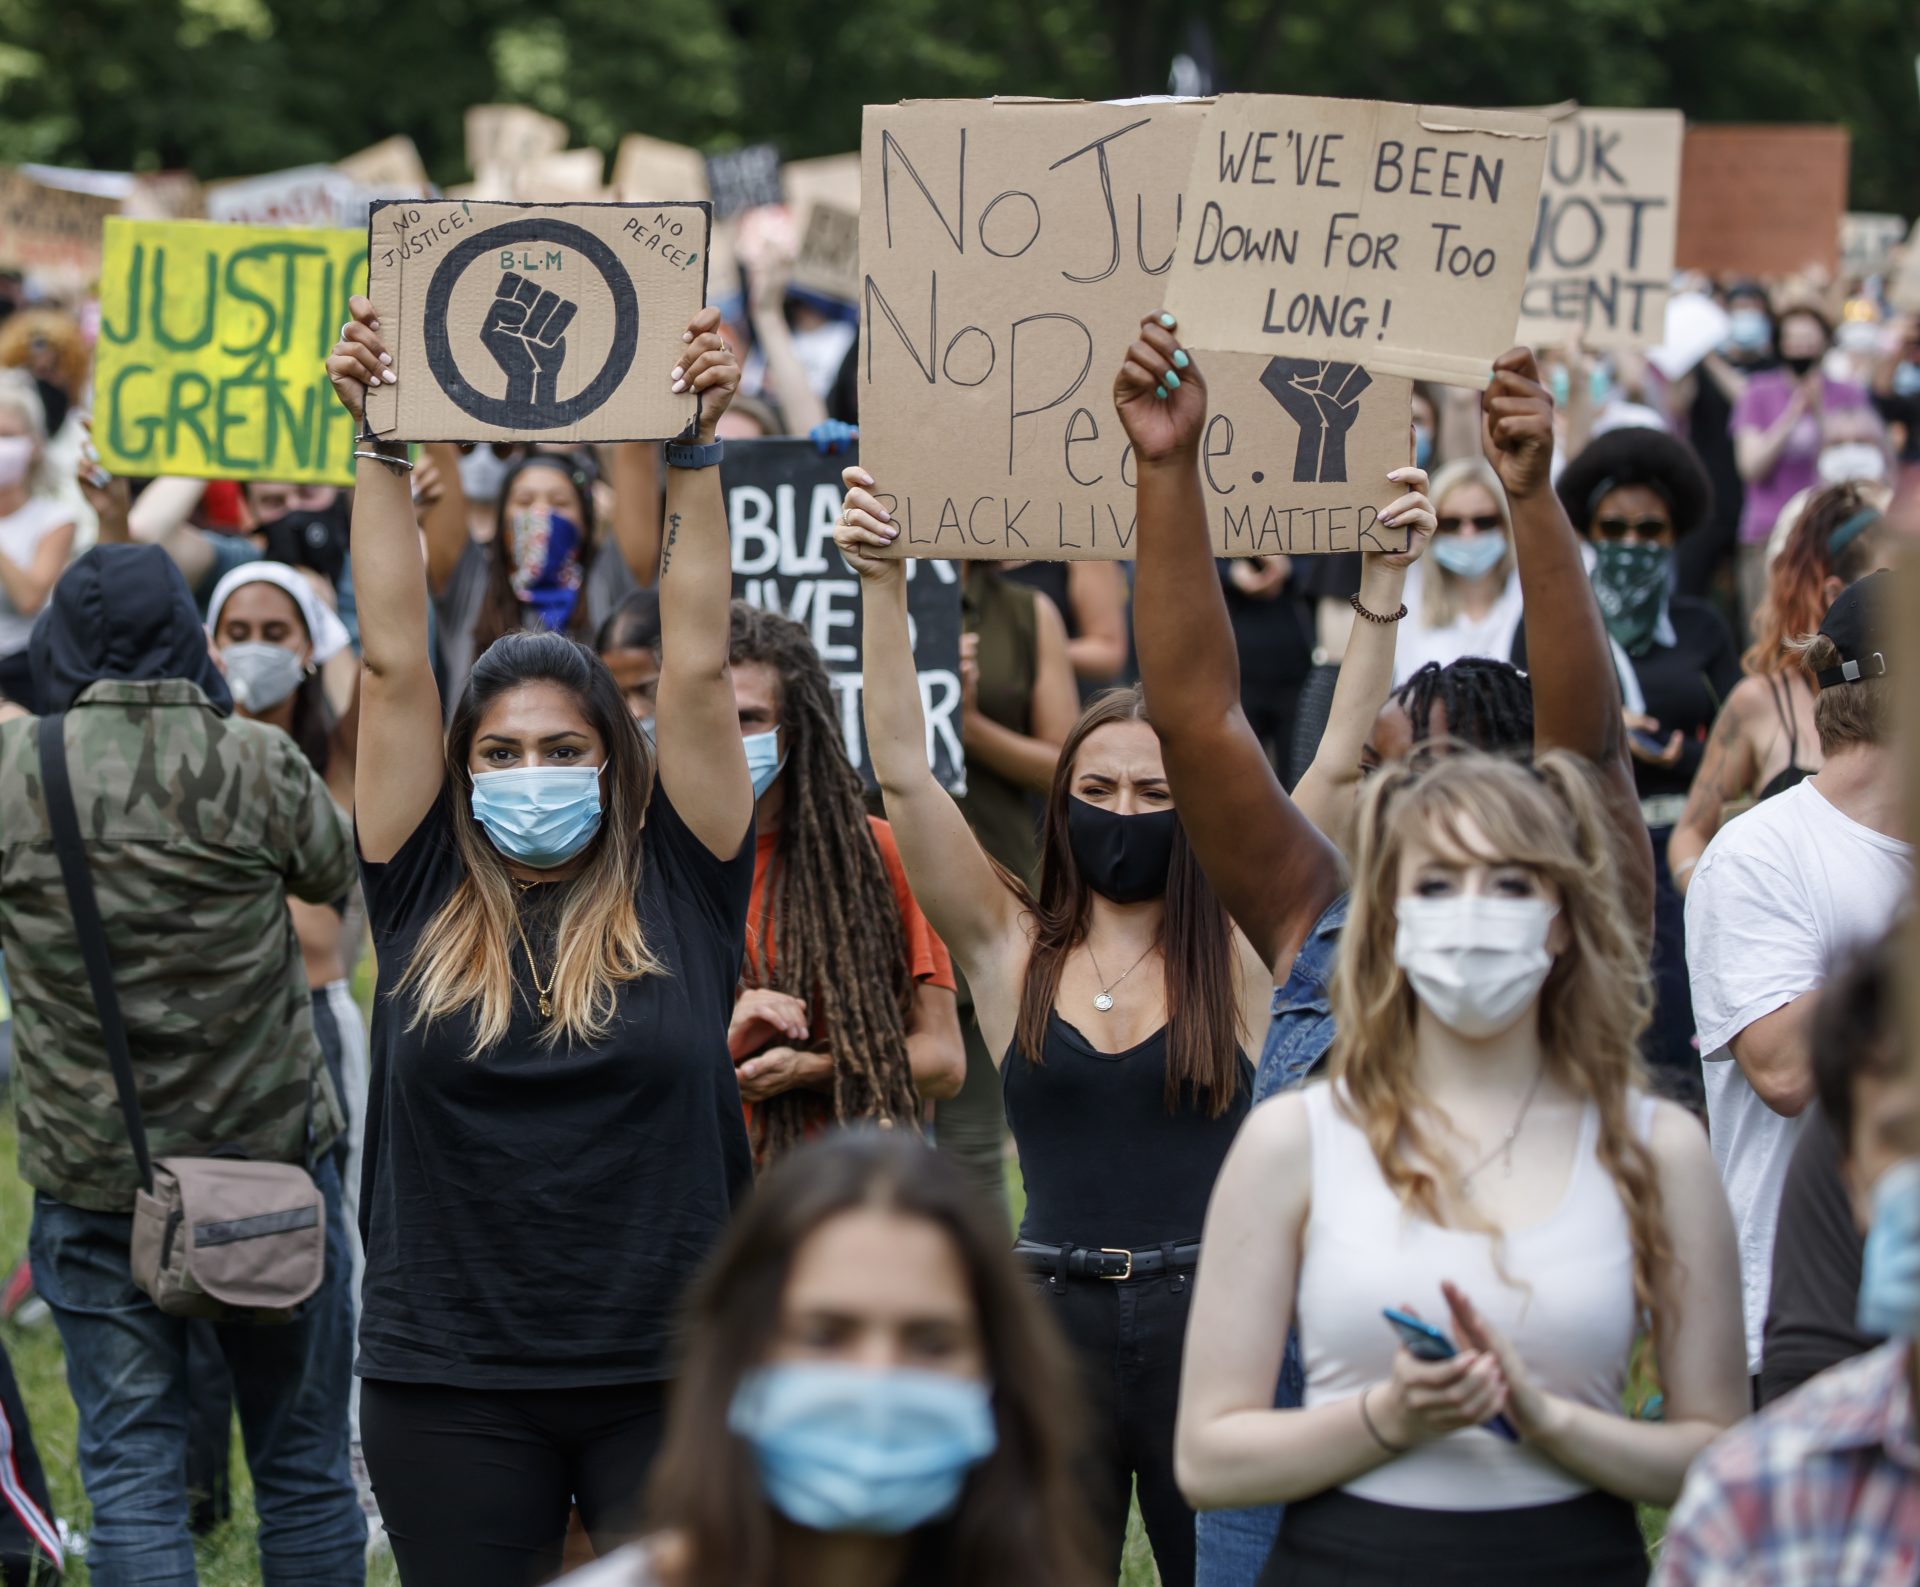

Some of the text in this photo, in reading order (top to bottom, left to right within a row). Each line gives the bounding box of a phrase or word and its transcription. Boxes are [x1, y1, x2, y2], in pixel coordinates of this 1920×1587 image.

[1218, 129, 1504, 204] WE'VE BEEN
[381, 202, 474, 268] JUSTICE!
[393, 209, 421, 235] NO
[623, 217, 698, 271] PEACE!
[653, 212, 683, 236] NO
[1262, 287, 1392, 341] LONG!
